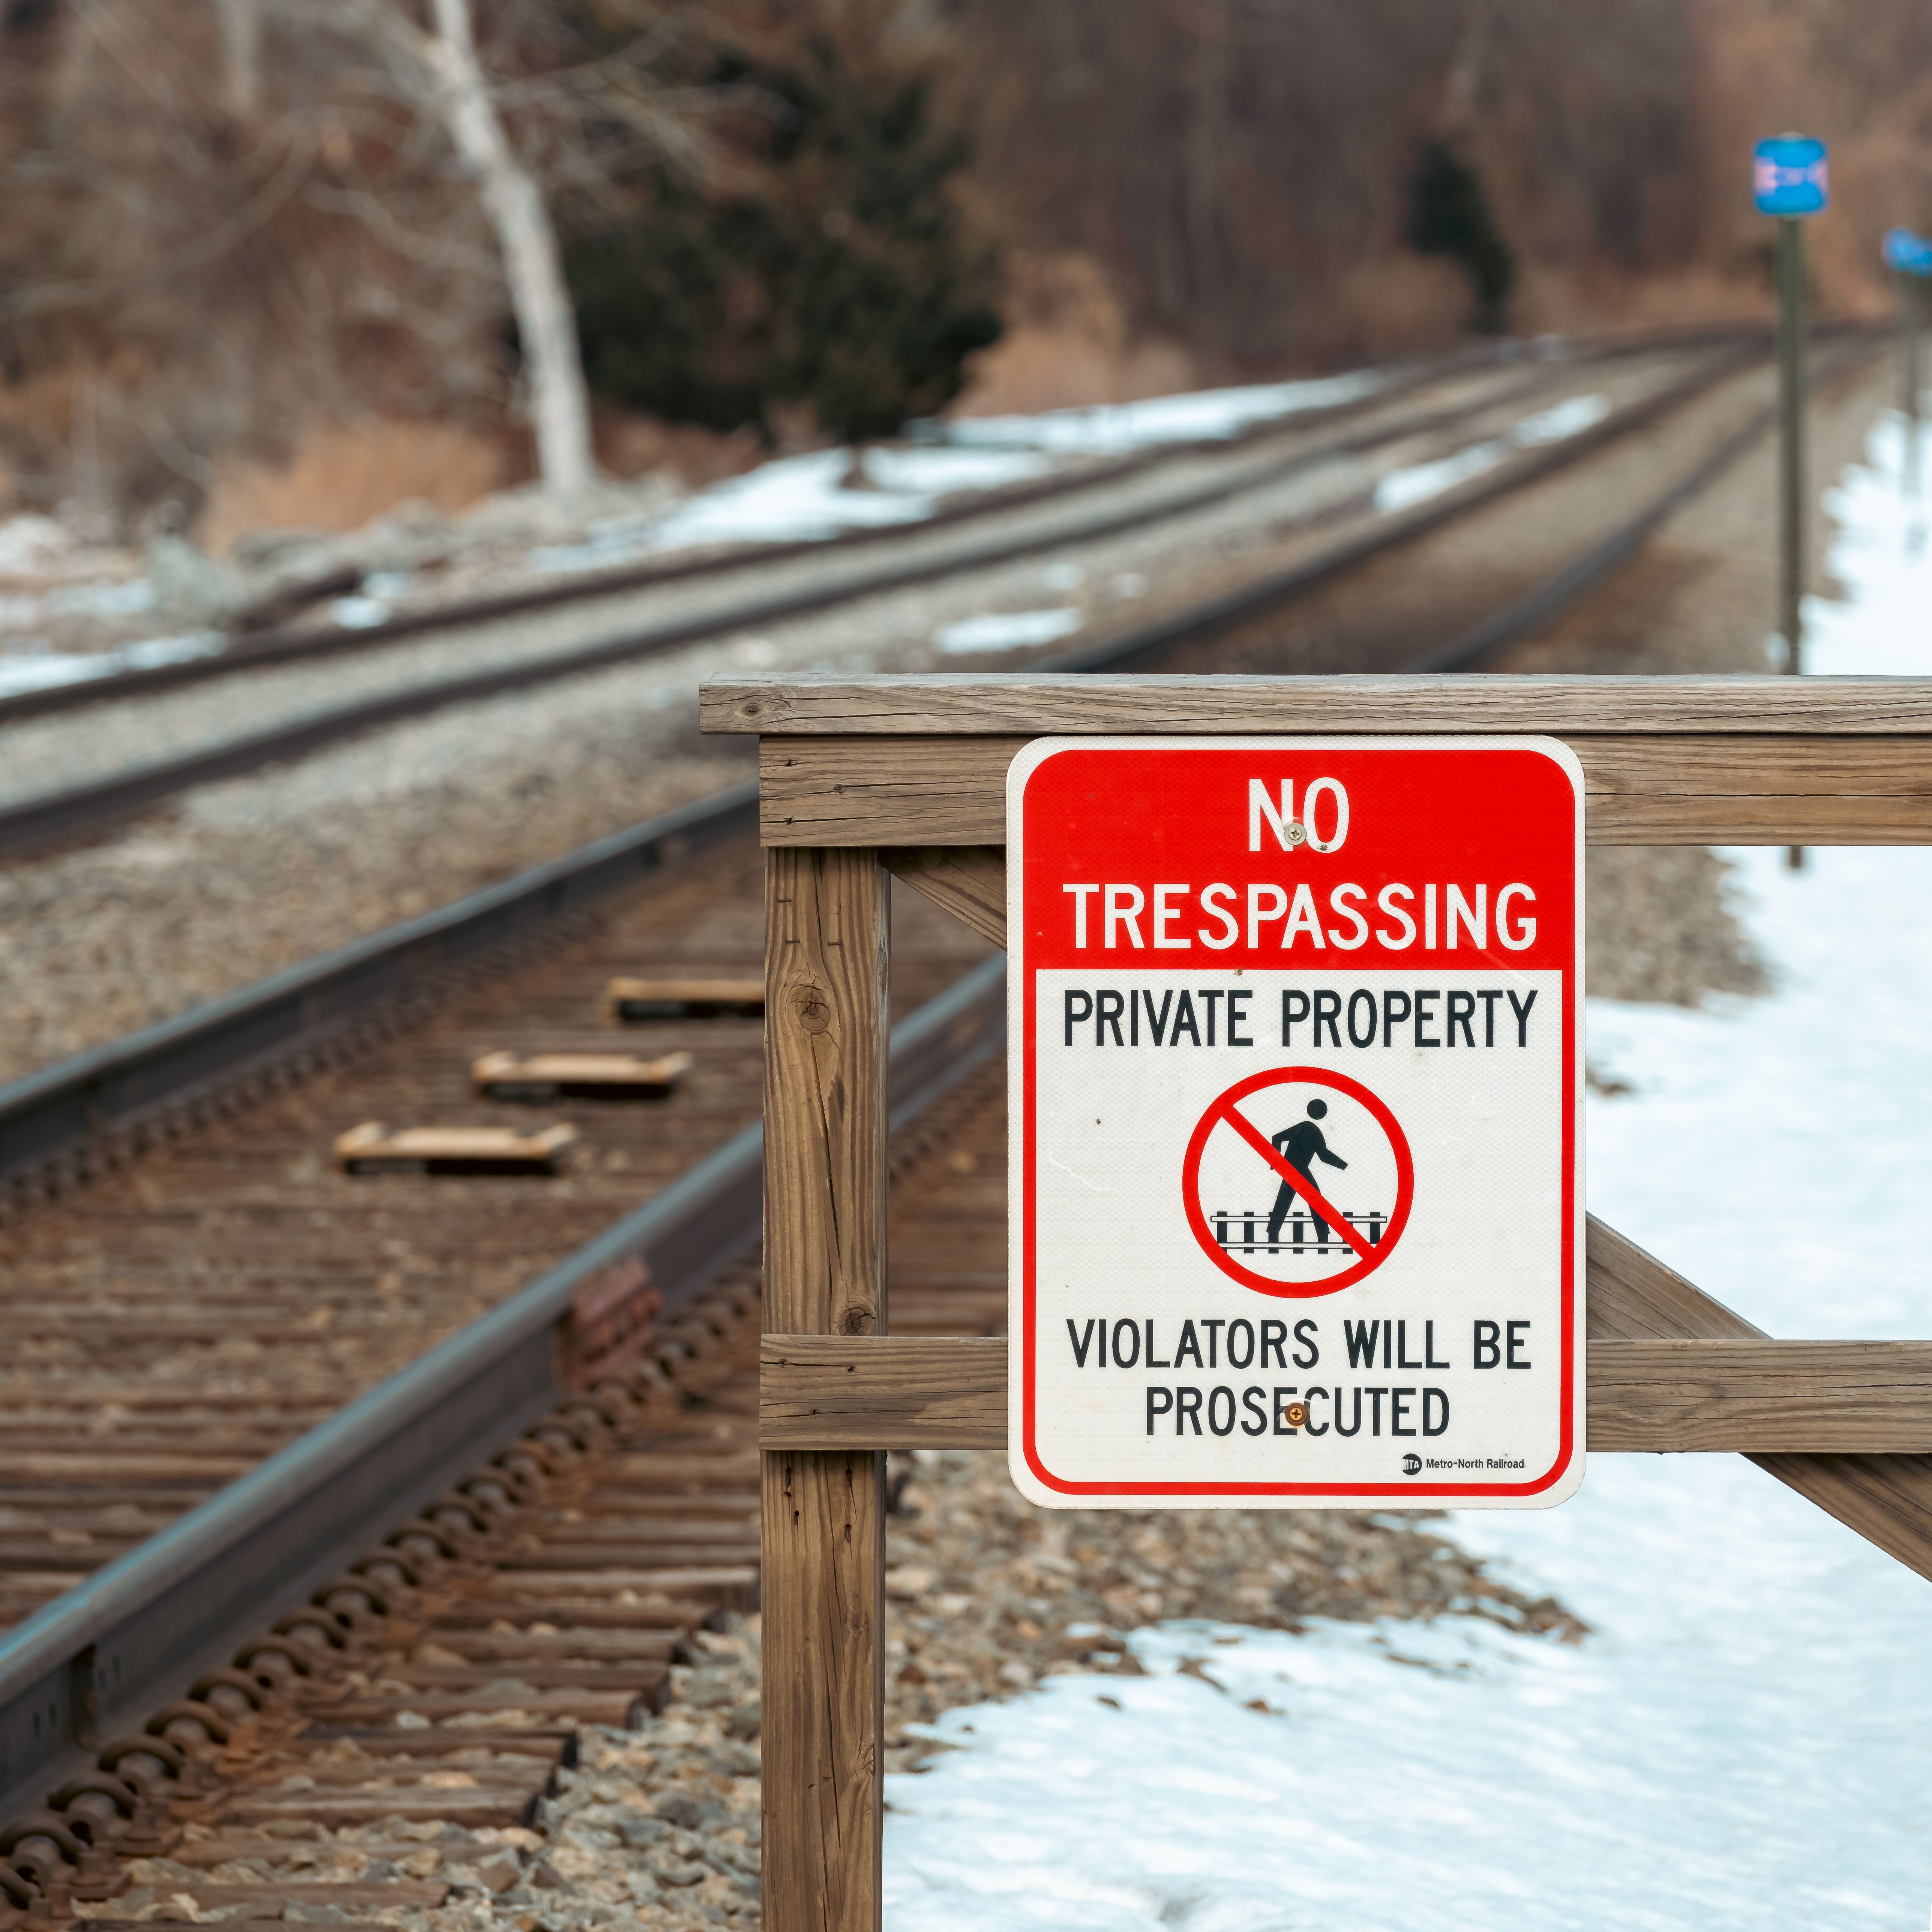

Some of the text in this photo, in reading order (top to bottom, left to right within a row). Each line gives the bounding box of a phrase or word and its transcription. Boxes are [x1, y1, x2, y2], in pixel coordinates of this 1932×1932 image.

[1250, 777, 1349, 853] NO
[1063, 883, 1536, 950] TRESPASSING
[1065, 989, 1538, 1048] PRIVATE PROPERTY
[1066, 1318, 1531, 1369] VIOLATORS WILL BE
[1147, 1386, 1449, 1437] PROSECUTED
[1402, 1458, 1524, 1471] MTA Metro-North Railroad
